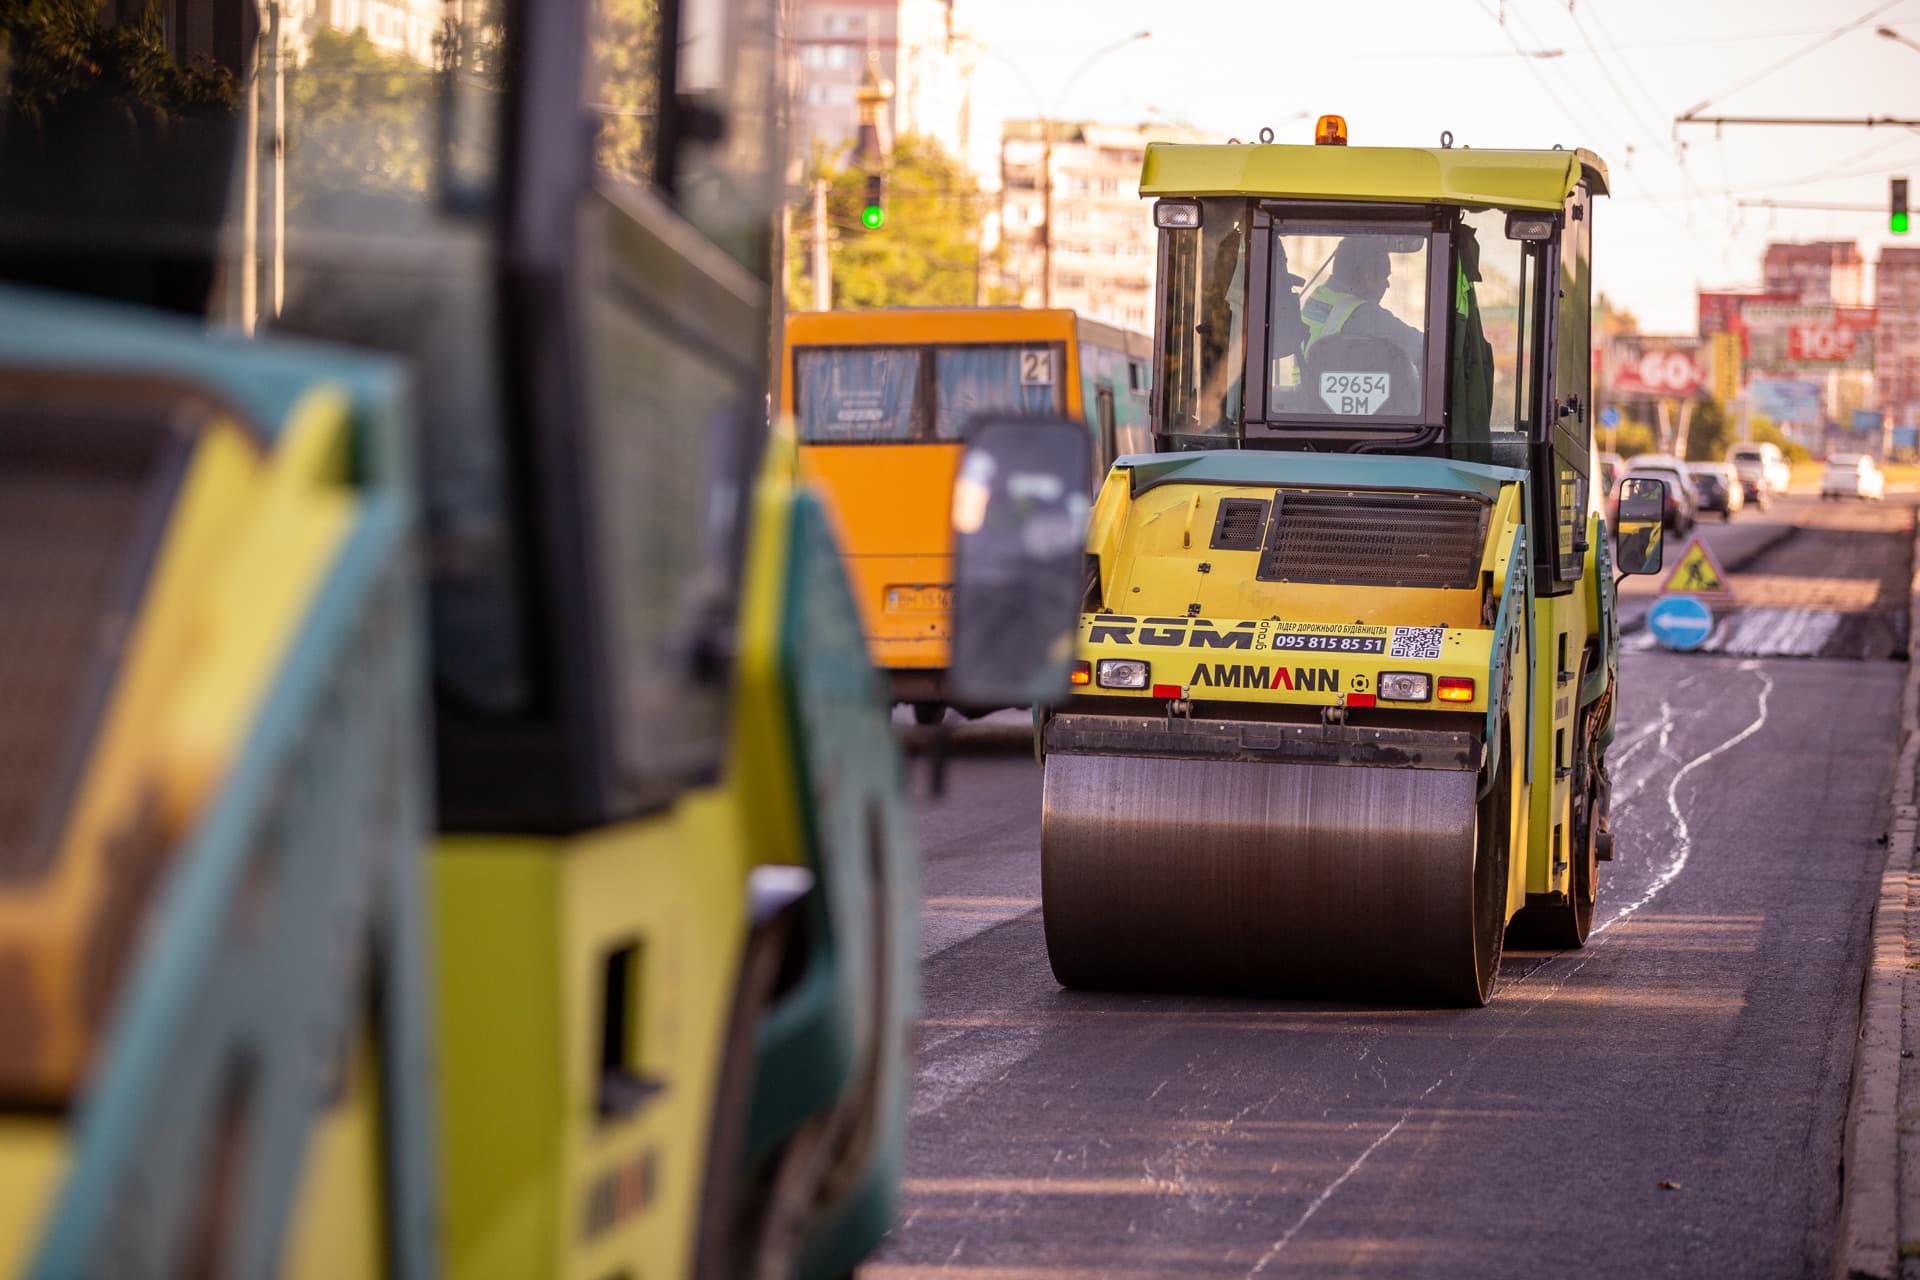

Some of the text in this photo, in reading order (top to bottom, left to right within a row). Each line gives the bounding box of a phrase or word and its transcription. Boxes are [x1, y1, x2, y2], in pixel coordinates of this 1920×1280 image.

[1025, 353, 1051, 381] 21
[1326, 375, 1386, 394] 29654
[1089, 615, 1257, 650] RGM
[1276, 635, 1383, 651] 095 815 85 51
[1190, 663, 1340, 692] AMMANN
